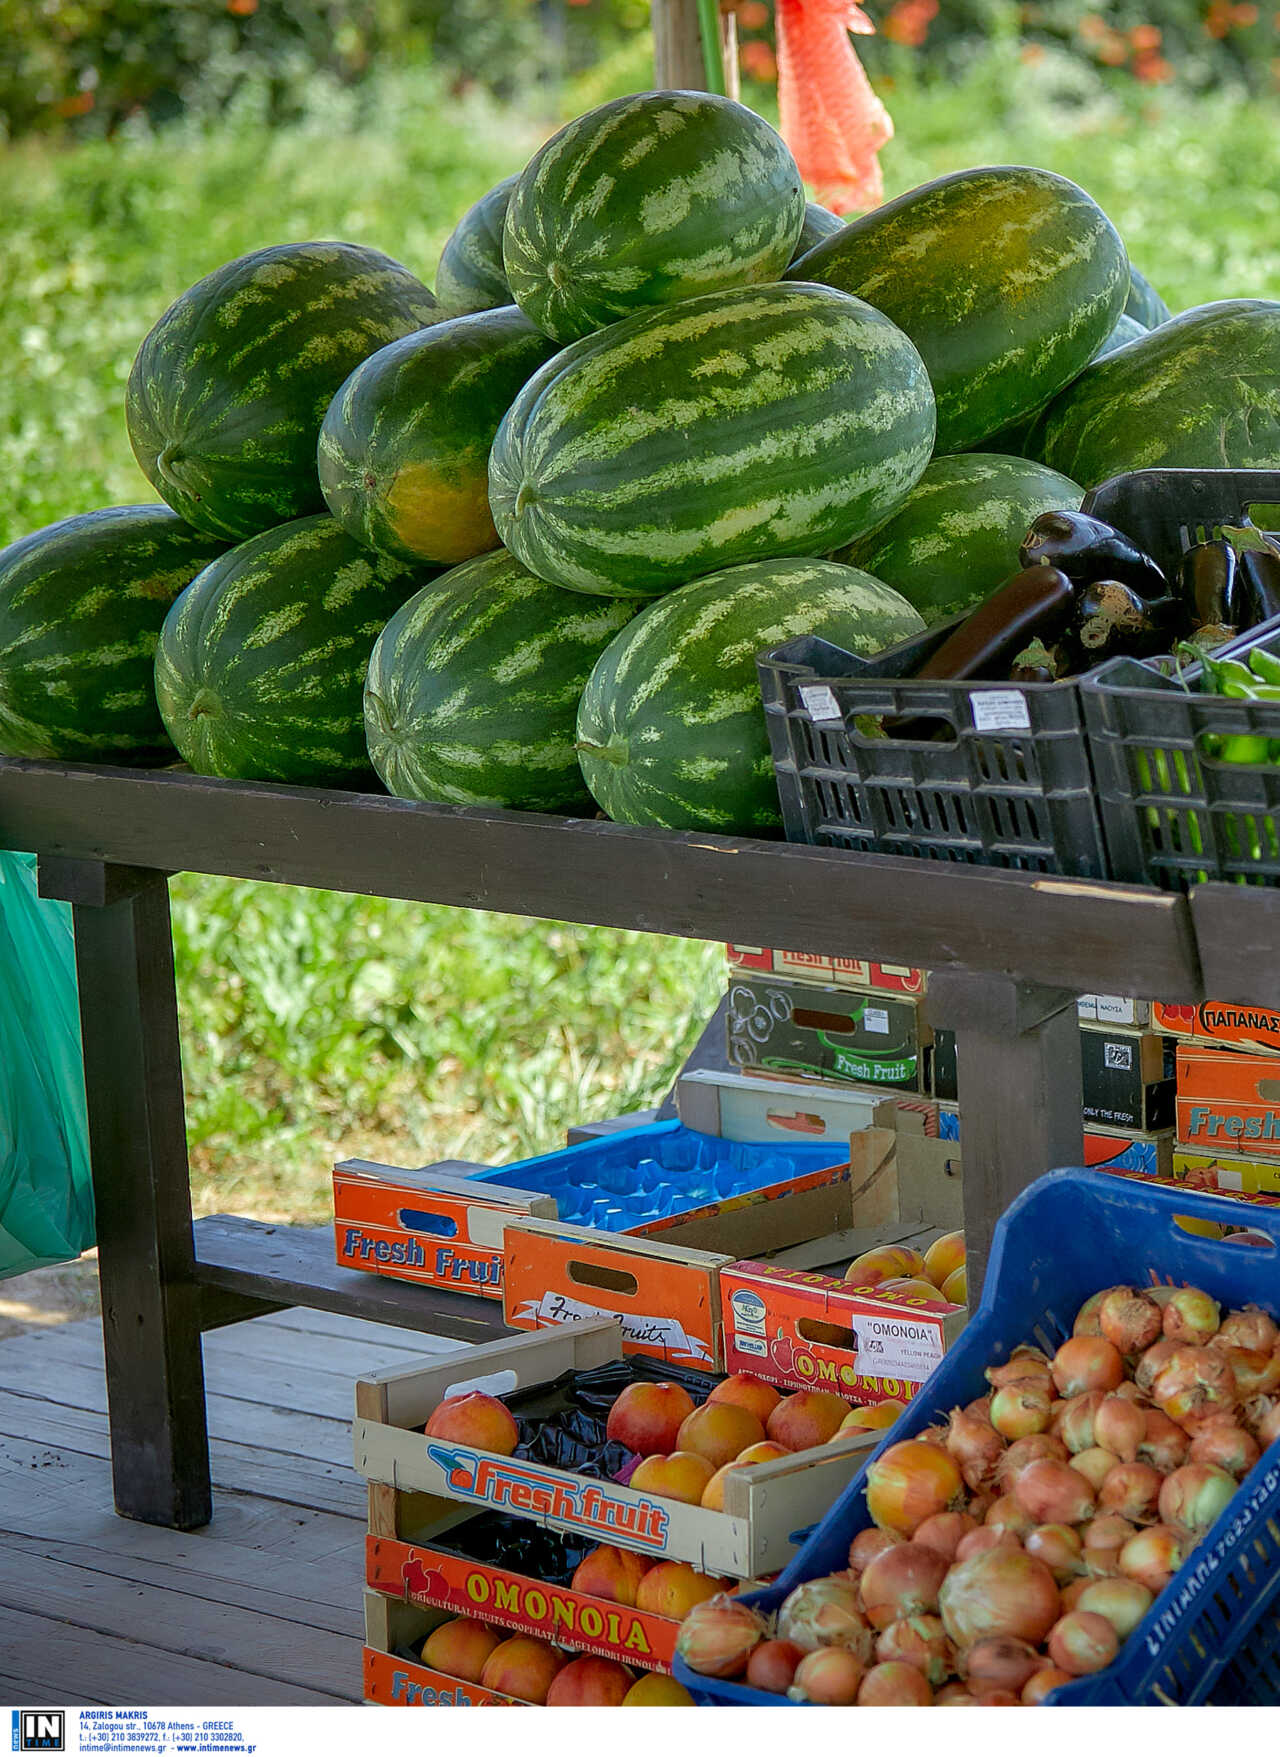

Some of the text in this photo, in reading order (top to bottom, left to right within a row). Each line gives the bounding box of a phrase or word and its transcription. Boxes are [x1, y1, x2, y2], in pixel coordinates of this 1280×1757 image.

[836, 1053, 907, 1081] Fresh Fruit
[1083, 1106, 1099, 1117] ONLY
[1100, 1109, 1113, 1119] THE
[344, 1228, 504, 1284] Fresh Frui
[763, 1266, 928, 1306] OMONOIA
[550, 1296, 601, 1321] Fre
[798, 1354, 920, 1400] OMONOI
[474, 1458, 577, 1520] Fresh
[466, 1573, 651, 1654] OMONOIA
[391, 1670, 472, 1706] Fresh
